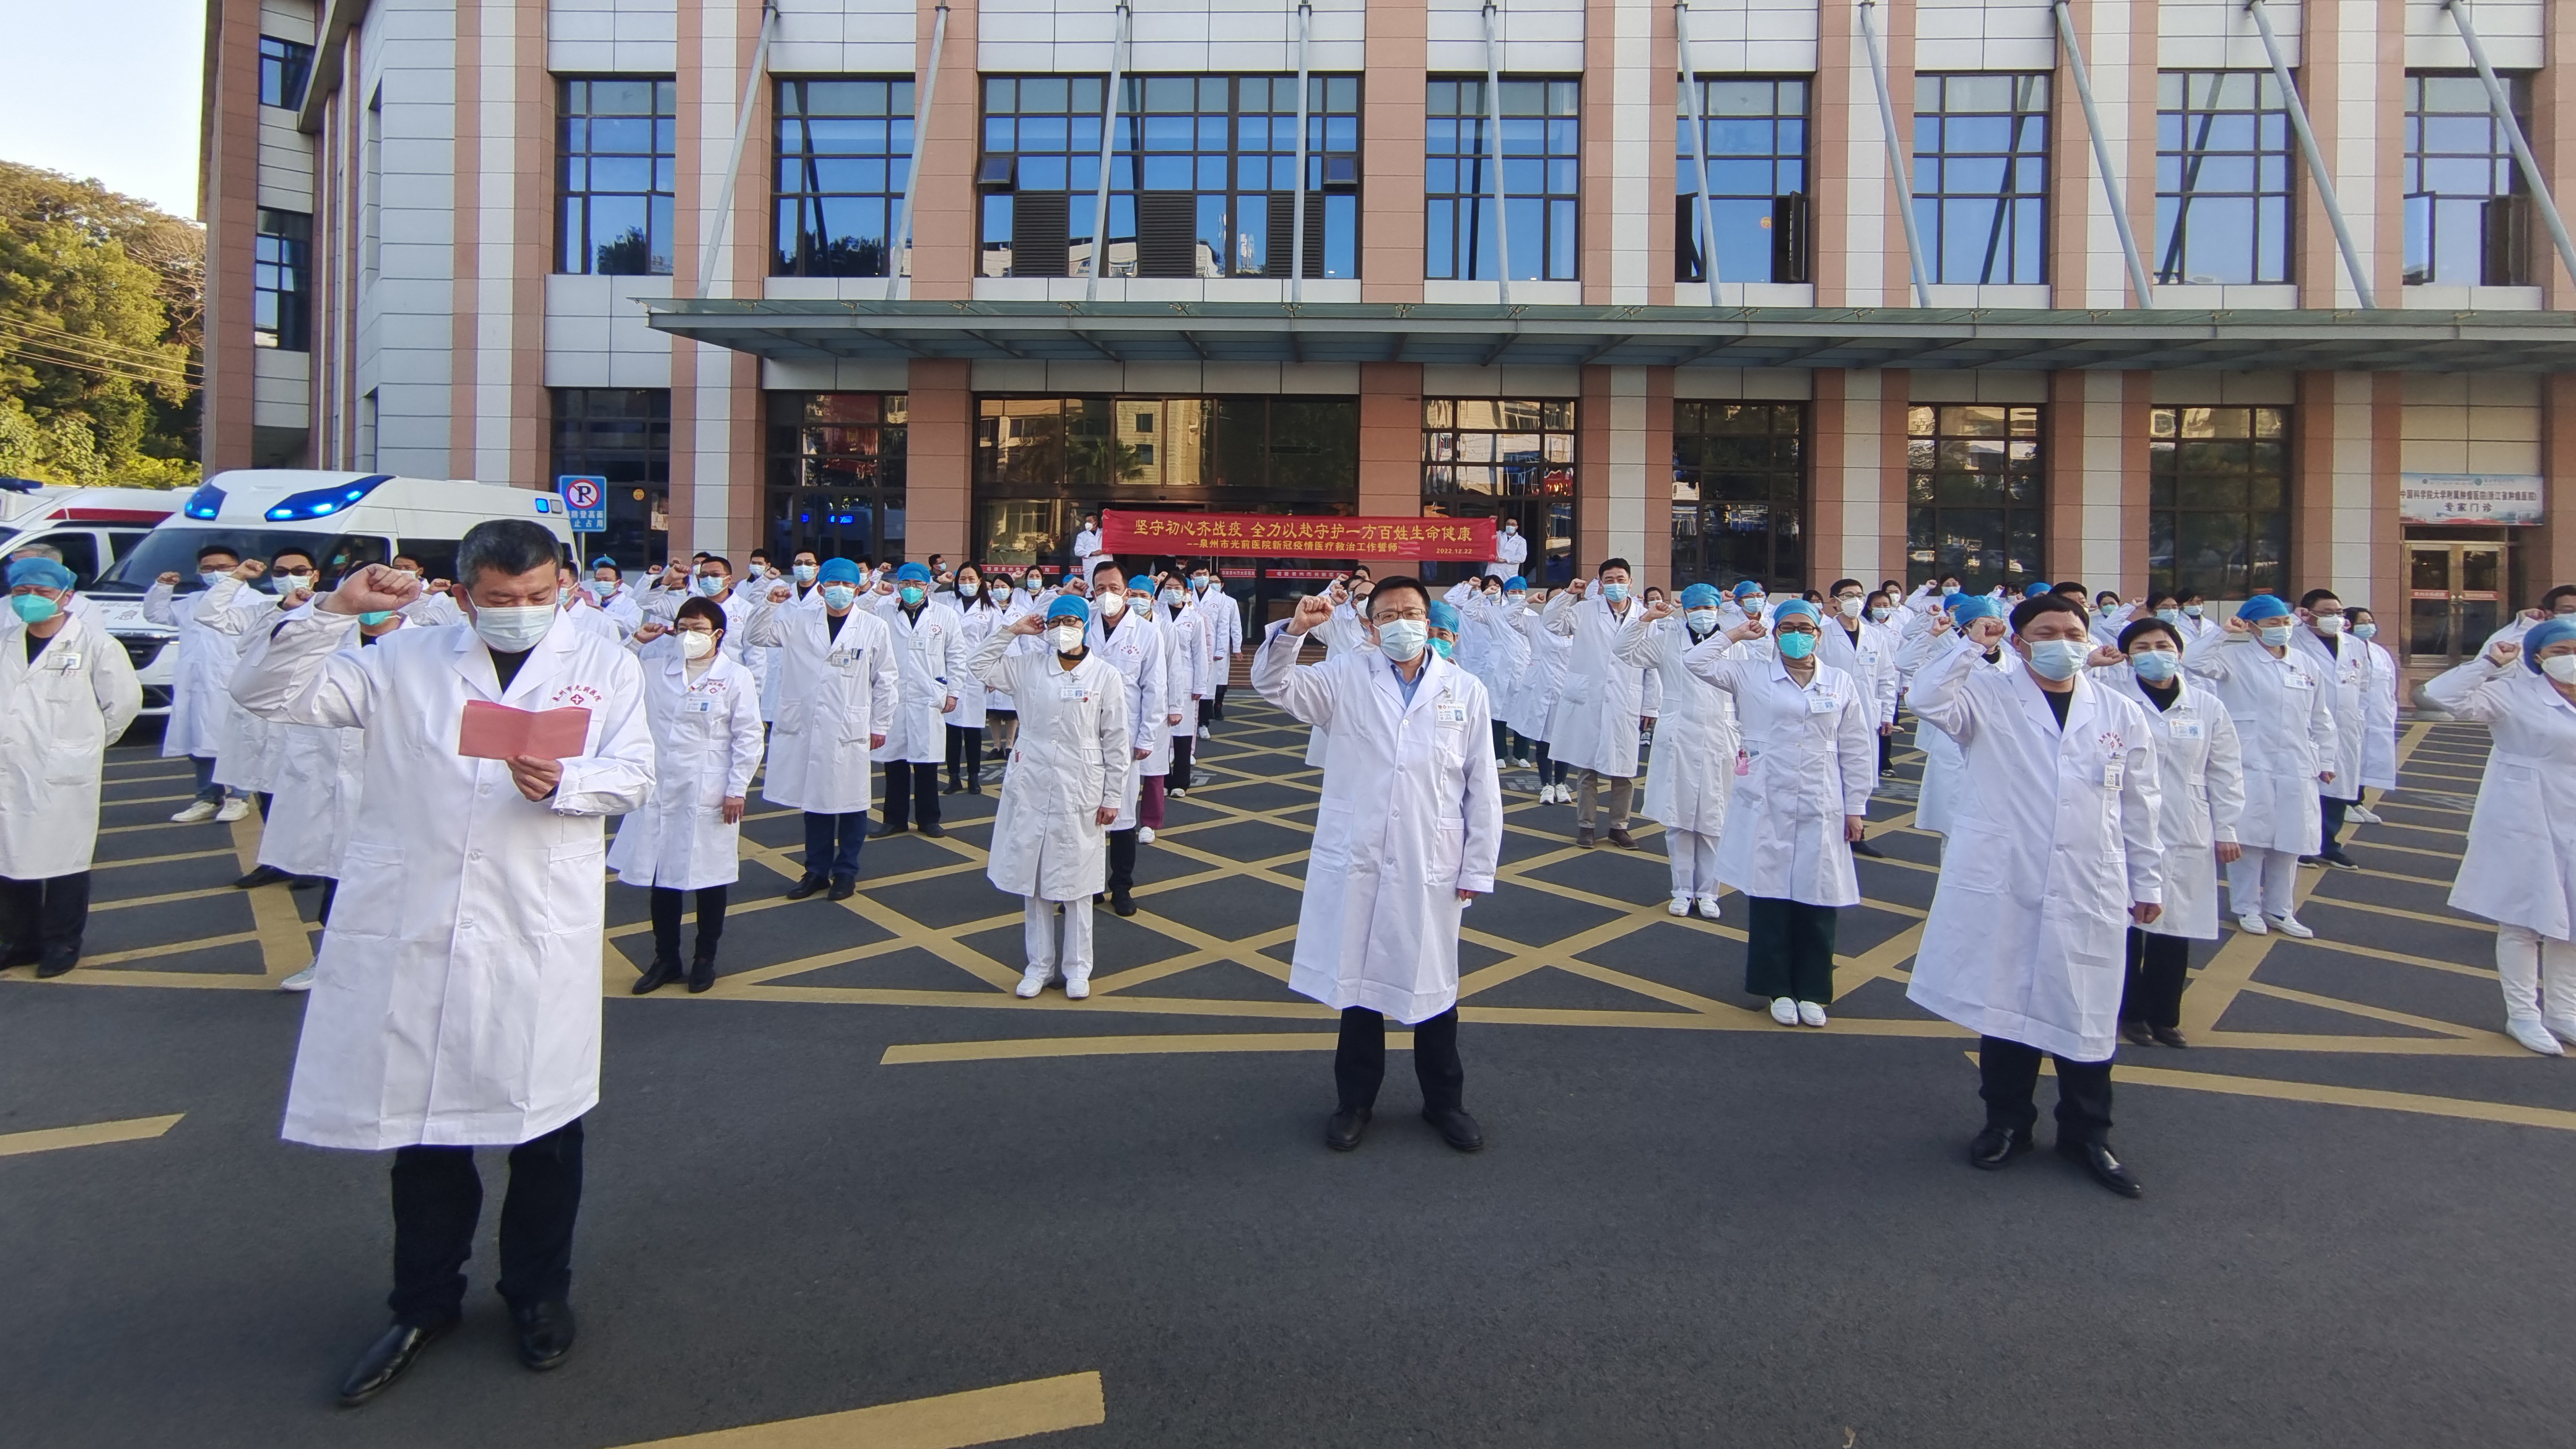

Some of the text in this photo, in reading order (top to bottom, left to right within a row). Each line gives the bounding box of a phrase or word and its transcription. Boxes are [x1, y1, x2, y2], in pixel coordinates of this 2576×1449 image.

[2444, 502, 2492, 513] 专家门诊
[568, 510, 604, 519] 防登高面
[1134, 519, 1473, 542] 坚守初心齐战疫 全力以赴守护一方百姓生命健康
